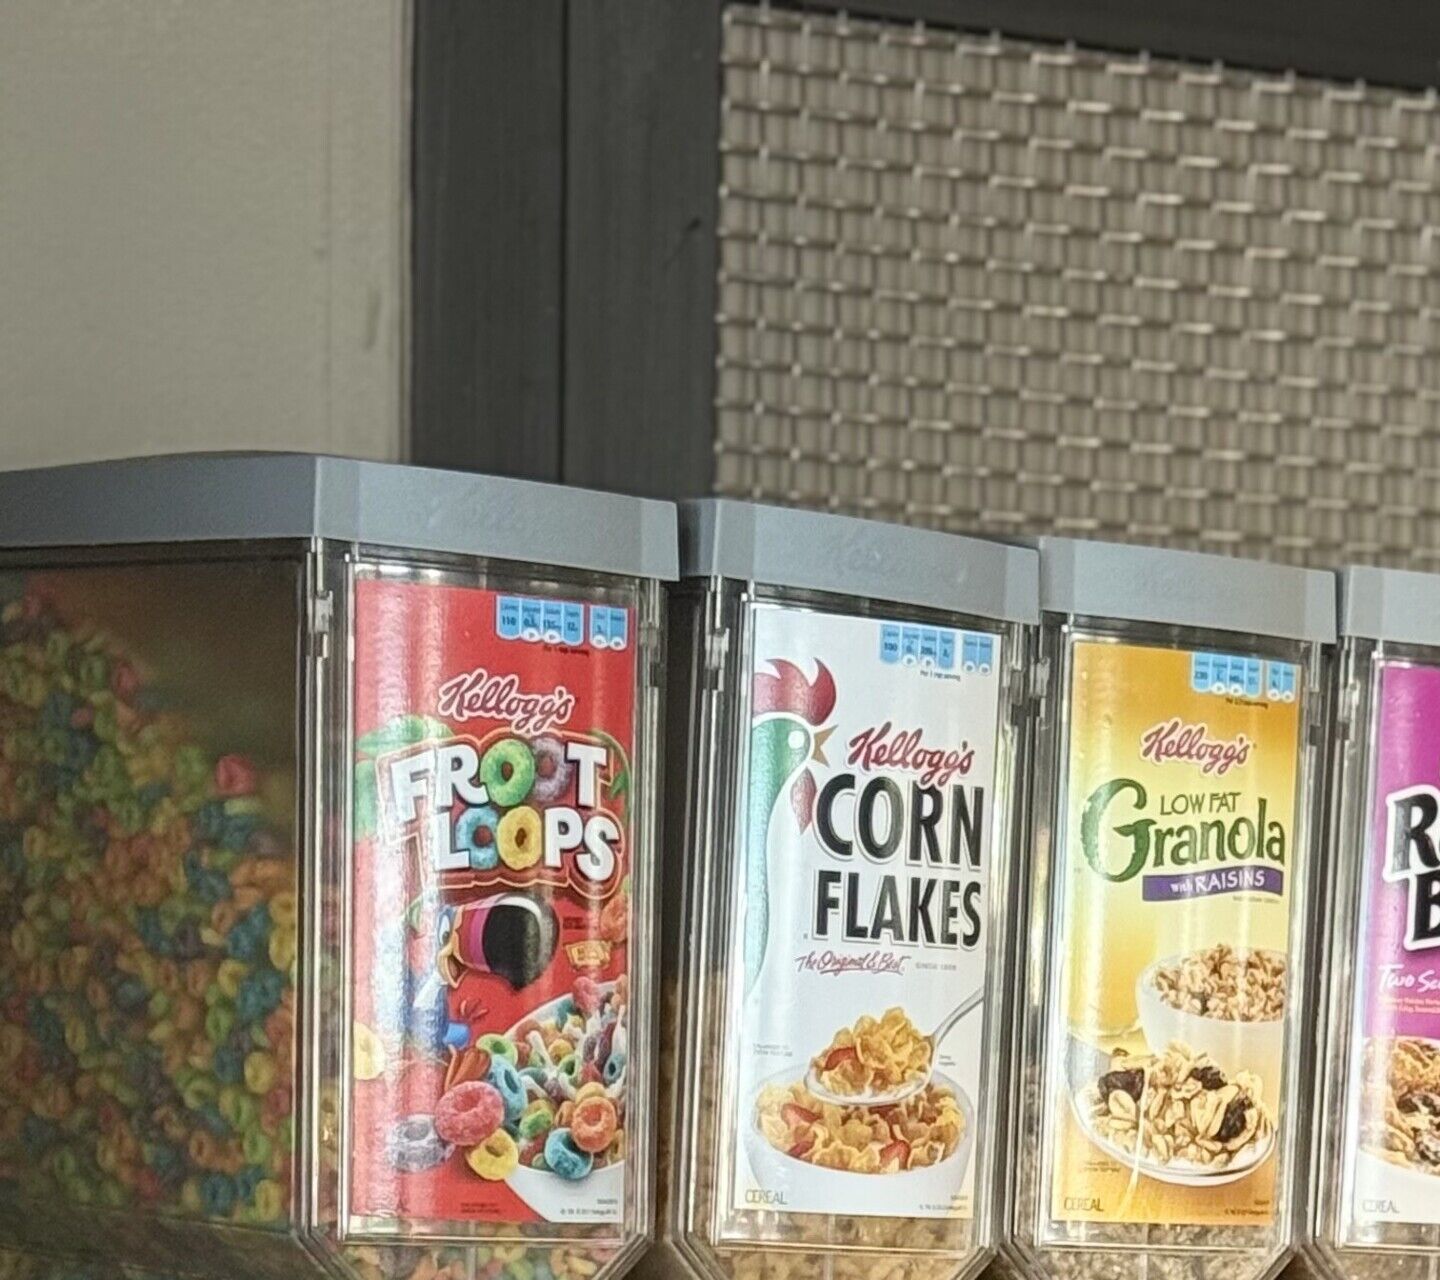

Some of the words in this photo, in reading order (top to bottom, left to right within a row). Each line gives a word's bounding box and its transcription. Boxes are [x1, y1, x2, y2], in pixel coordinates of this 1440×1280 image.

[440, 669, 574, 733] Kellogg's
[849, 720, 976, 787] Kellogg's
[1142, 720, 1250, 774] Kellogg's
[389, 737, 607, 824] FROOT
[1160, 793, 1206, 816] LOW
[1208, 792, 1242, 813] FAT
[433, 805, 621, 882] LOOPS
[815, 772, 986, 868] CORN
[1080, 777, 1285, 882] Granola
[813, 870, 983, 948] FLAKES
[1170, 879, 1193, 893] with
[1194, 870, 1265, 893] RAISINS
[794, 950, 816, 971] The
[1379, 963, 1415, 993] Two
